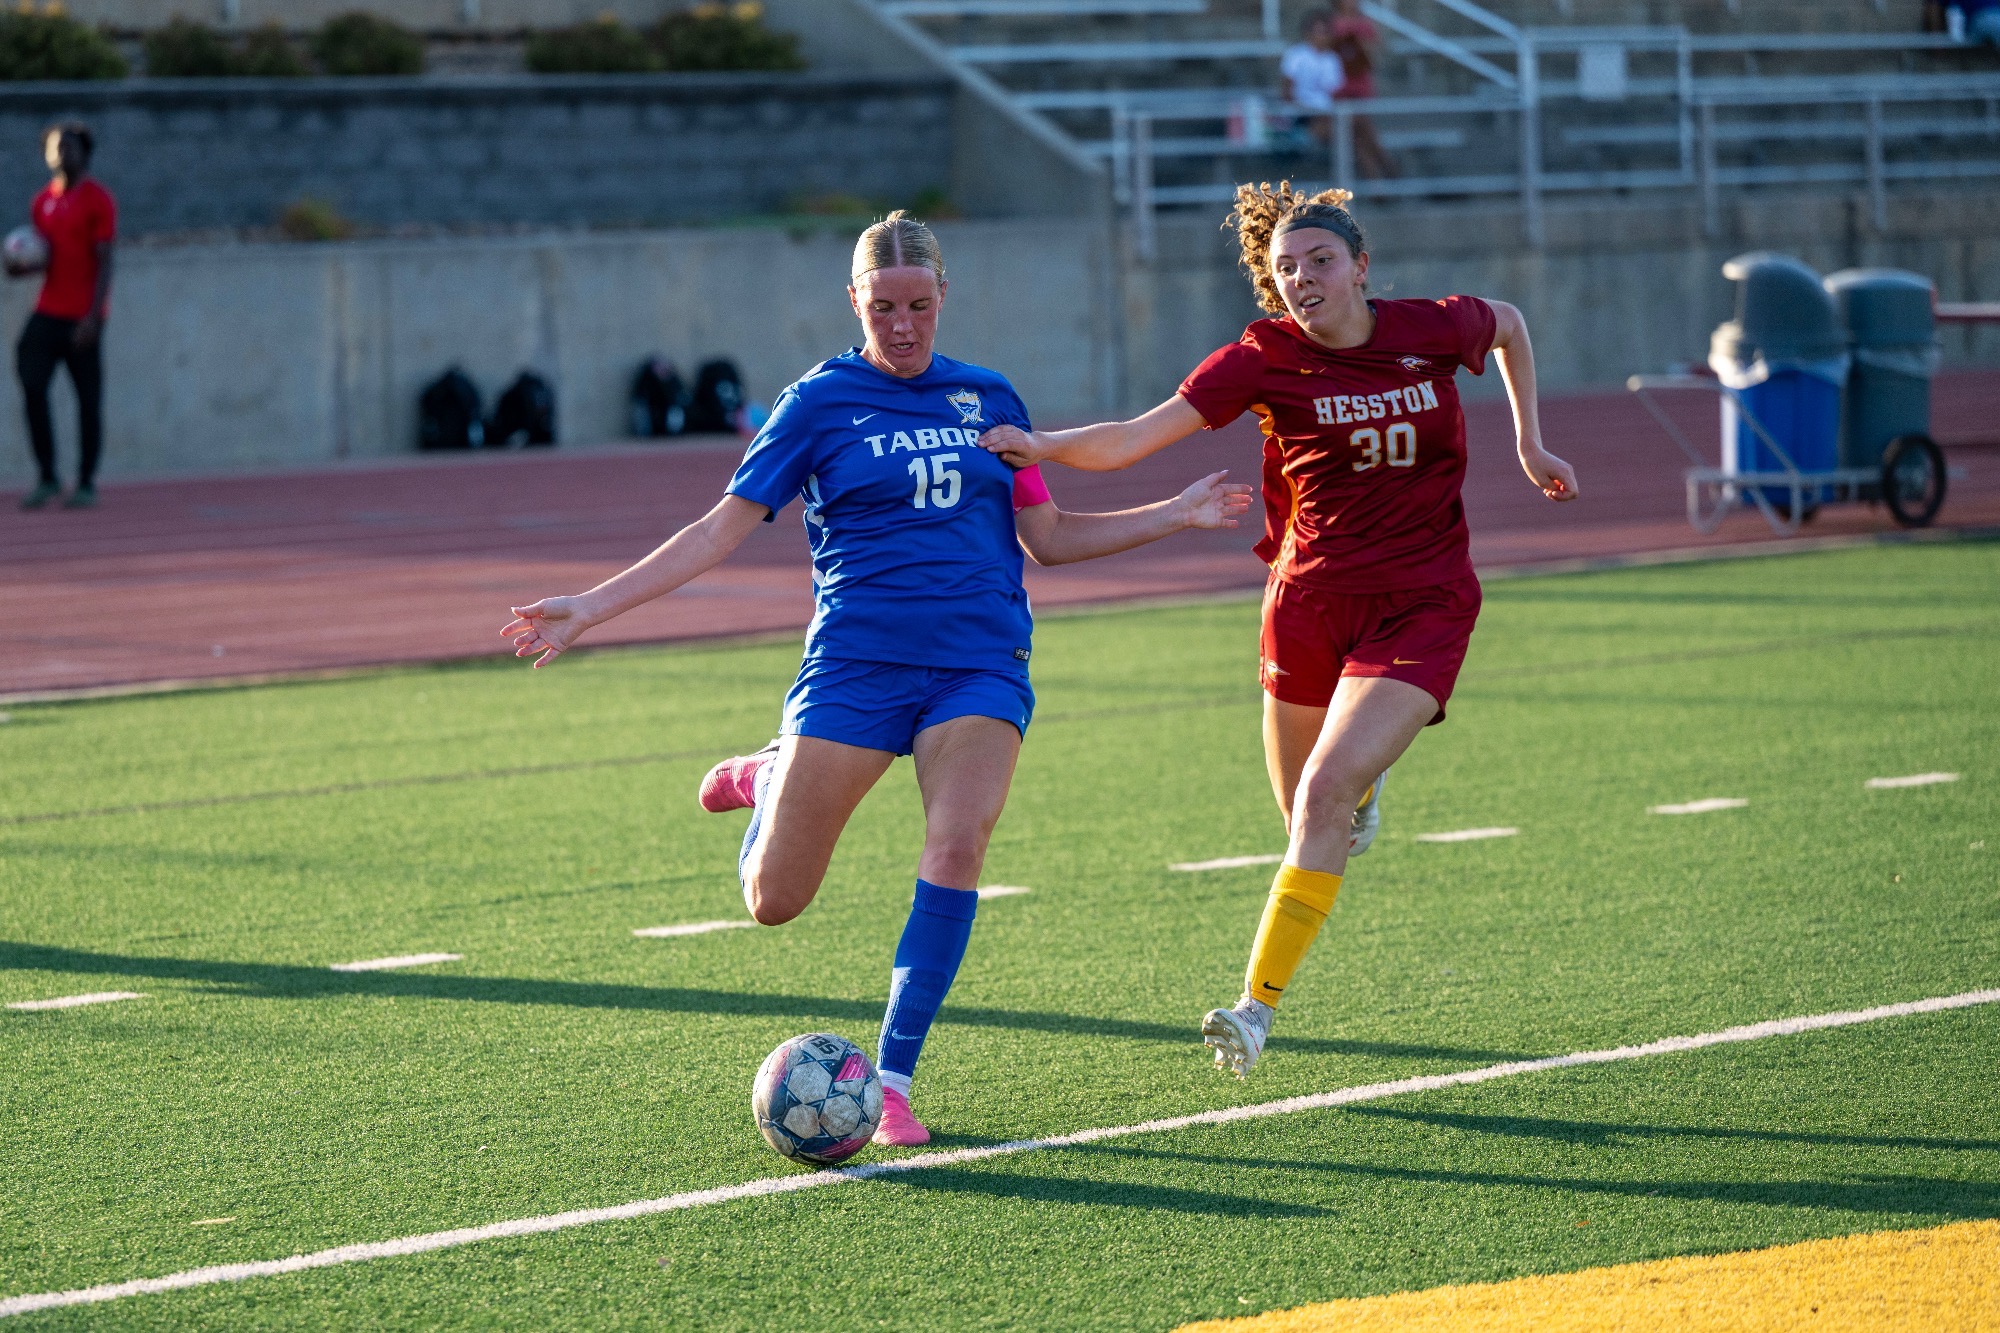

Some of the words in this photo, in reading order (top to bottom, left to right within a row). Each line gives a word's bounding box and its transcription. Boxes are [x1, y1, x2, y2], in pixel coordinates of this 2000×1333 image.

[1313, 380, 1439, 424] HESSTON
[864, 427, 980, 458] TABOR
[1349, 421, 1417, 472] 30
[907, 453, 962, 509] 15
